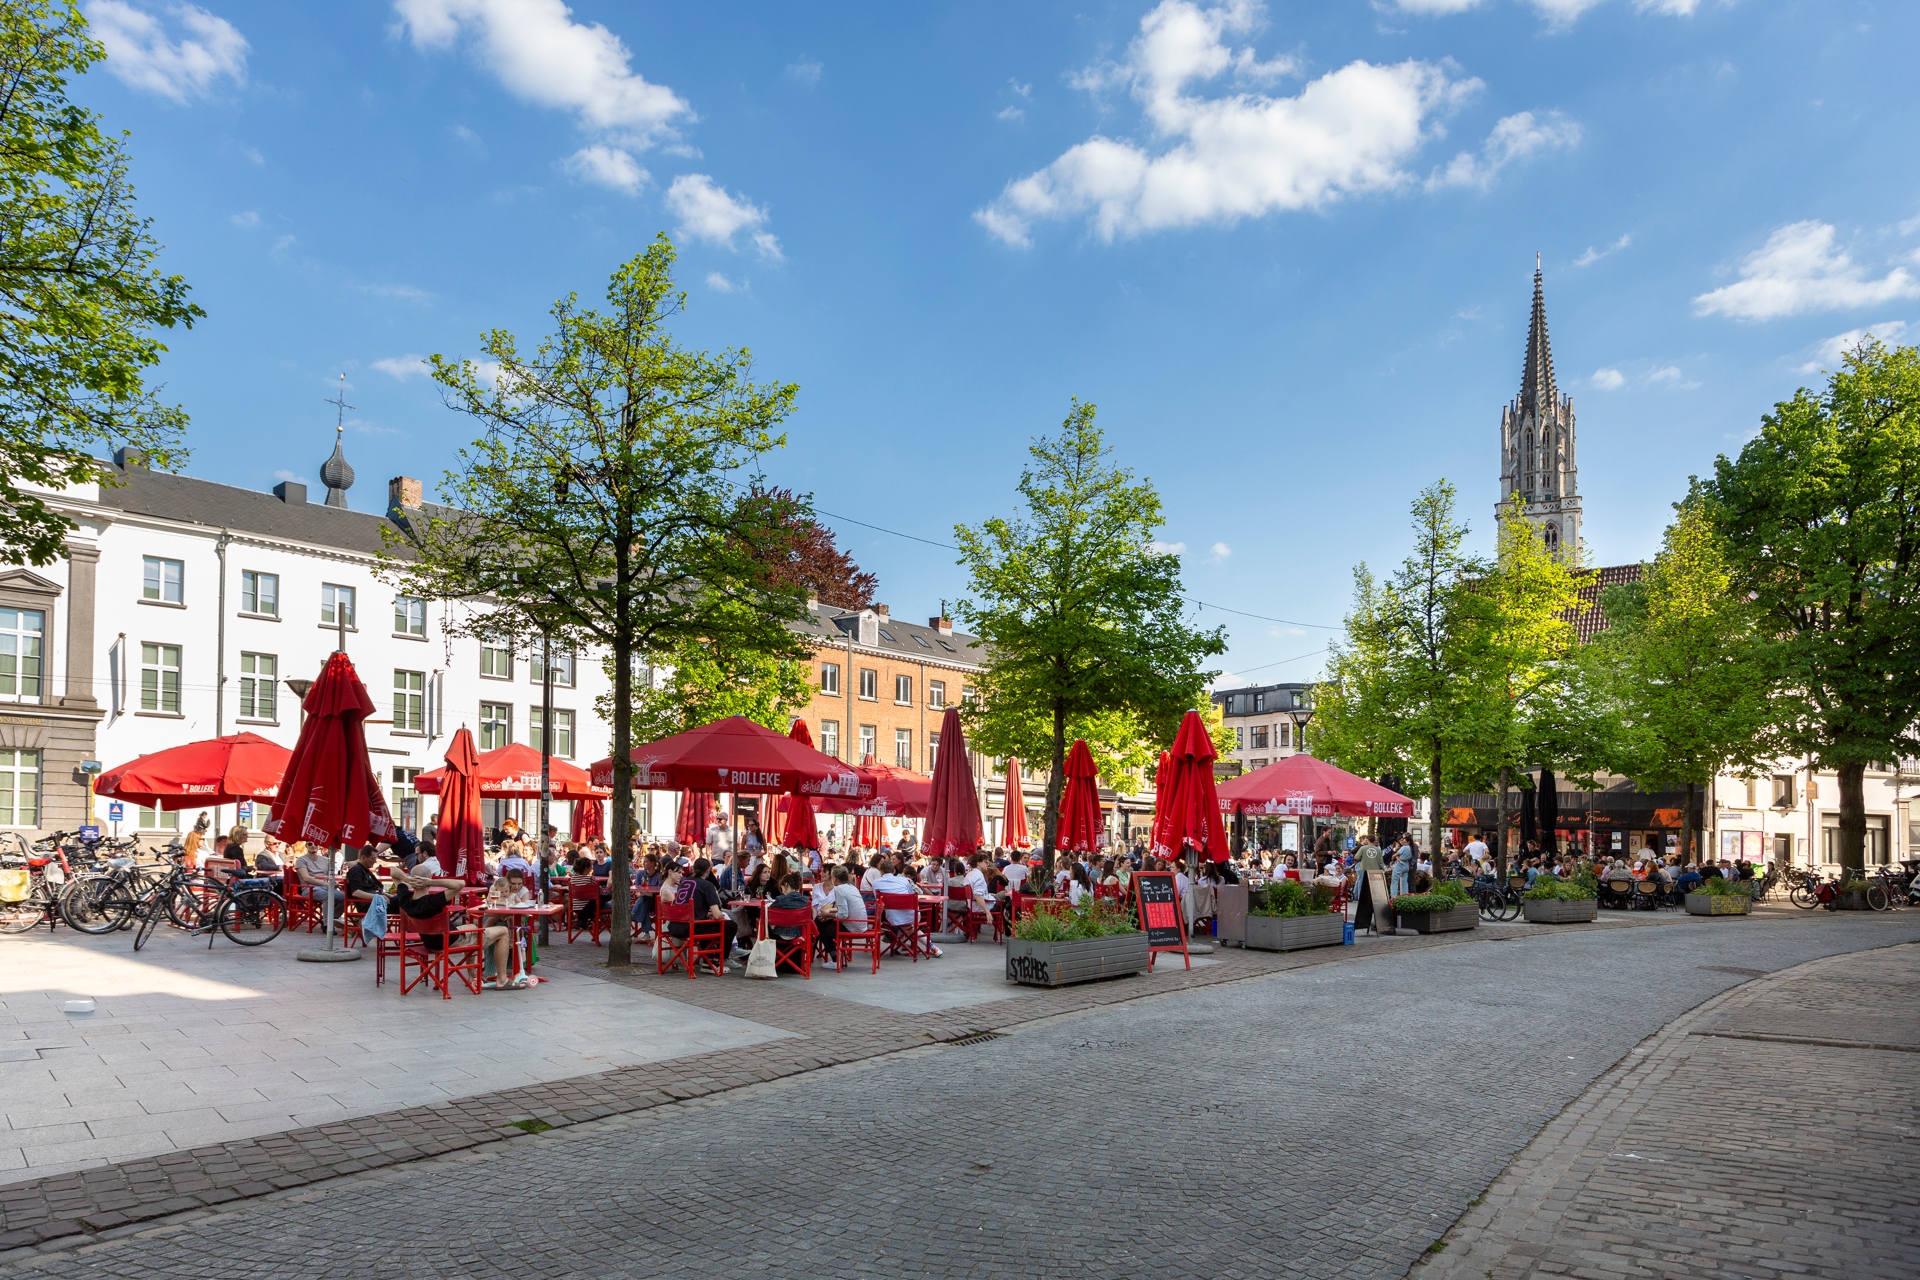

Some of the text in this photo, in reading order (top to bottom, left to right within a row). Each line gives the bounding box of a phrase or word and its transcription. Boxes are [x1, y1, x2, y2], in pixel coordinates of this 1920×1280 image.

[731, 770, 781, 787] BOLLEKE
[189, 784, 216, 793] BOLLEKE
[1373, 802, 1403, 814] BOLLEKE
